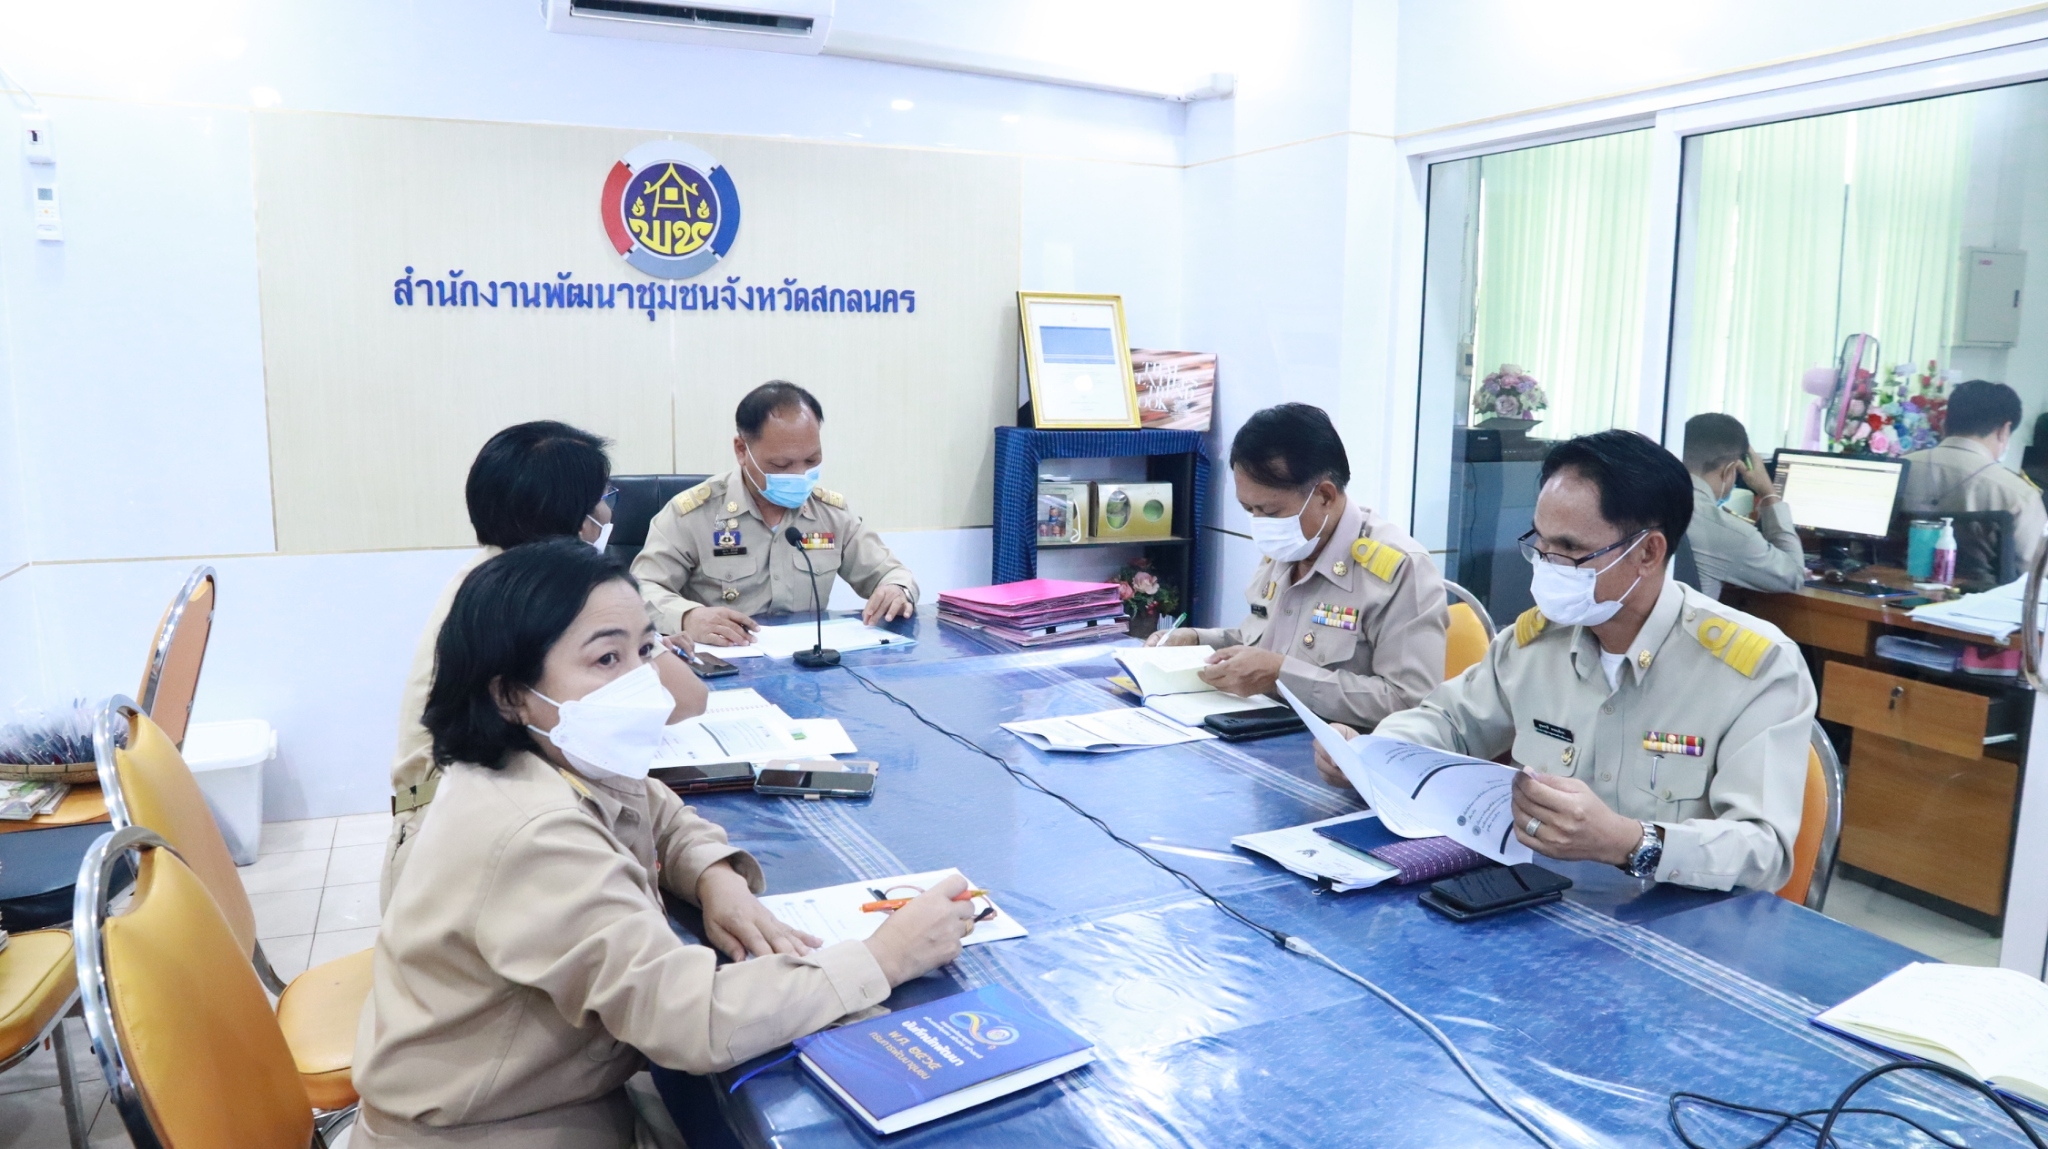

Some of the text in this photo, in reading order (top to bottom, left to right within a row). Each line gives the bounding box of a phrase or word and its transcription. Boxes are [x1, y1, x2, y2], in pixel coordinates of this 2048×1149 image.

[393, 265, 916, 322] สำนักงานพัฒนาชุมชนจังหวัดสกลนคร
[1137, 396, 1168, 411] OOK
[901, 1020, 964, 1067] บันทึกนักพัฒนา
